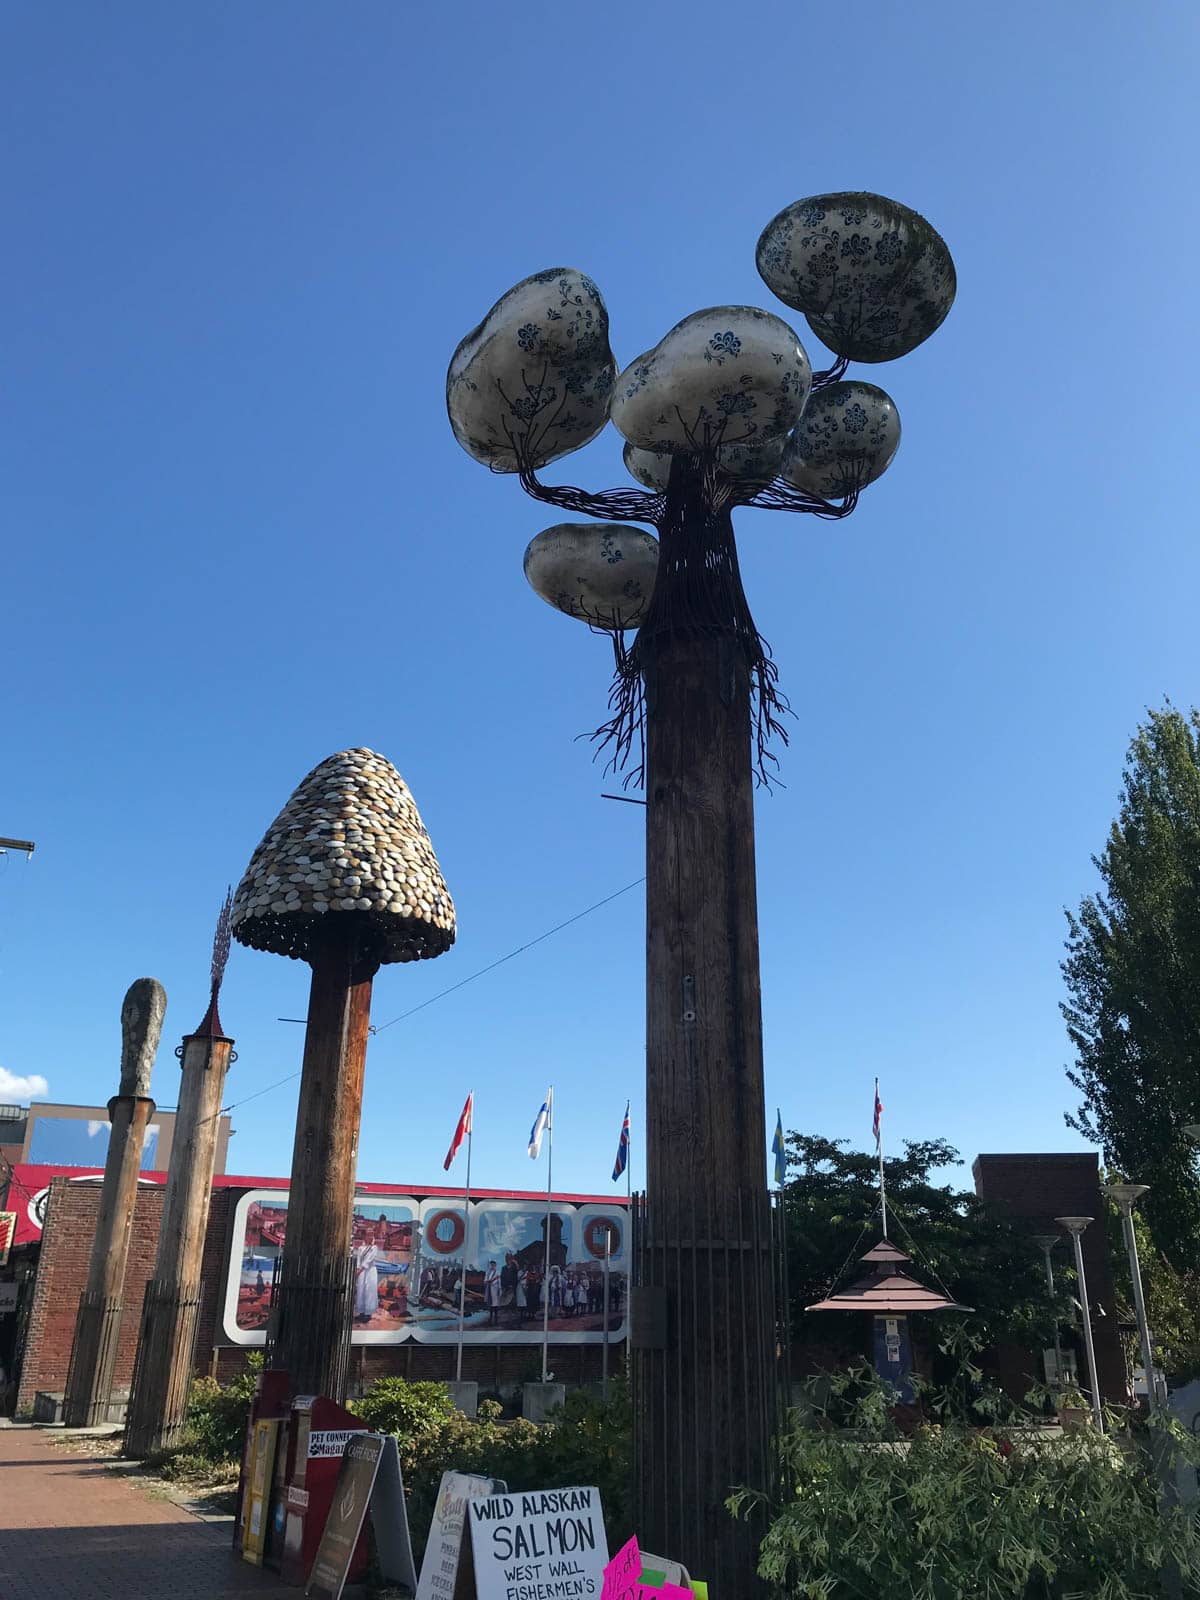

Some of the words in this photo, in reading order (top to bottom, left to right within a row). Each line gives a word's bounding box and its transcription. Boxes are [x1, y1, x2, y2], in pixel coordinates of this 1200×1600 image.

[311, 1432, 325, 1443] PET
[326, 1432, 353, 1442] CONNEC
[319, 1444, 346, 1455] Magaz
[472, 1498, 514, 1521] WILD
[522, 1489, 591, 1518] ALASKAN
[492, 1517, 596, 1561] SALMON
[504, 1564, 543, 1581] WEST
[548, 1560, 585, 1577] WALL
[506, 1576, 596, 1600] FISHERMEN'S
